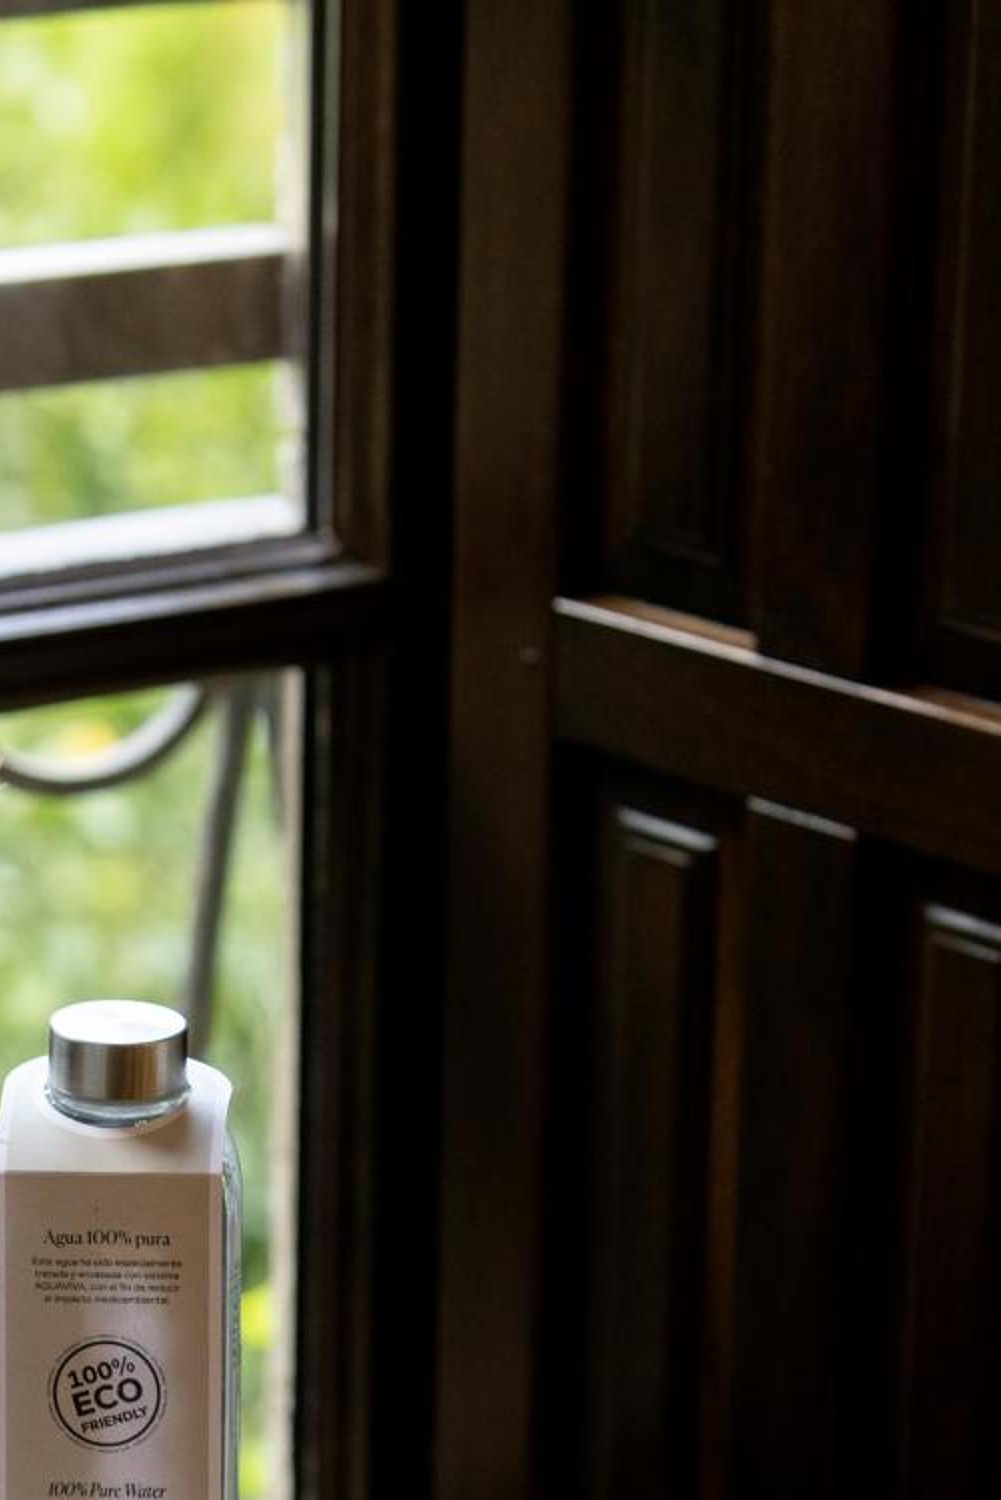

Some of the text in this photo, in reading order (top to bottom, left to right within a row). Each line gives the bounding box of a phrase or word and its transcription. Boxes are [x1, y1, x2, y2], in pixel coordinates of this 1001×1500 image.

[43, 1229, 170, 1249] Agua 100% pura
[67, 1356, 136, 1389] 100%
[71, 1378, 143, 1417] ECO
[80, 1406, 148, 1434] FRIENDLY
[48, 1481, 167, 1498] 100% Pure Water
